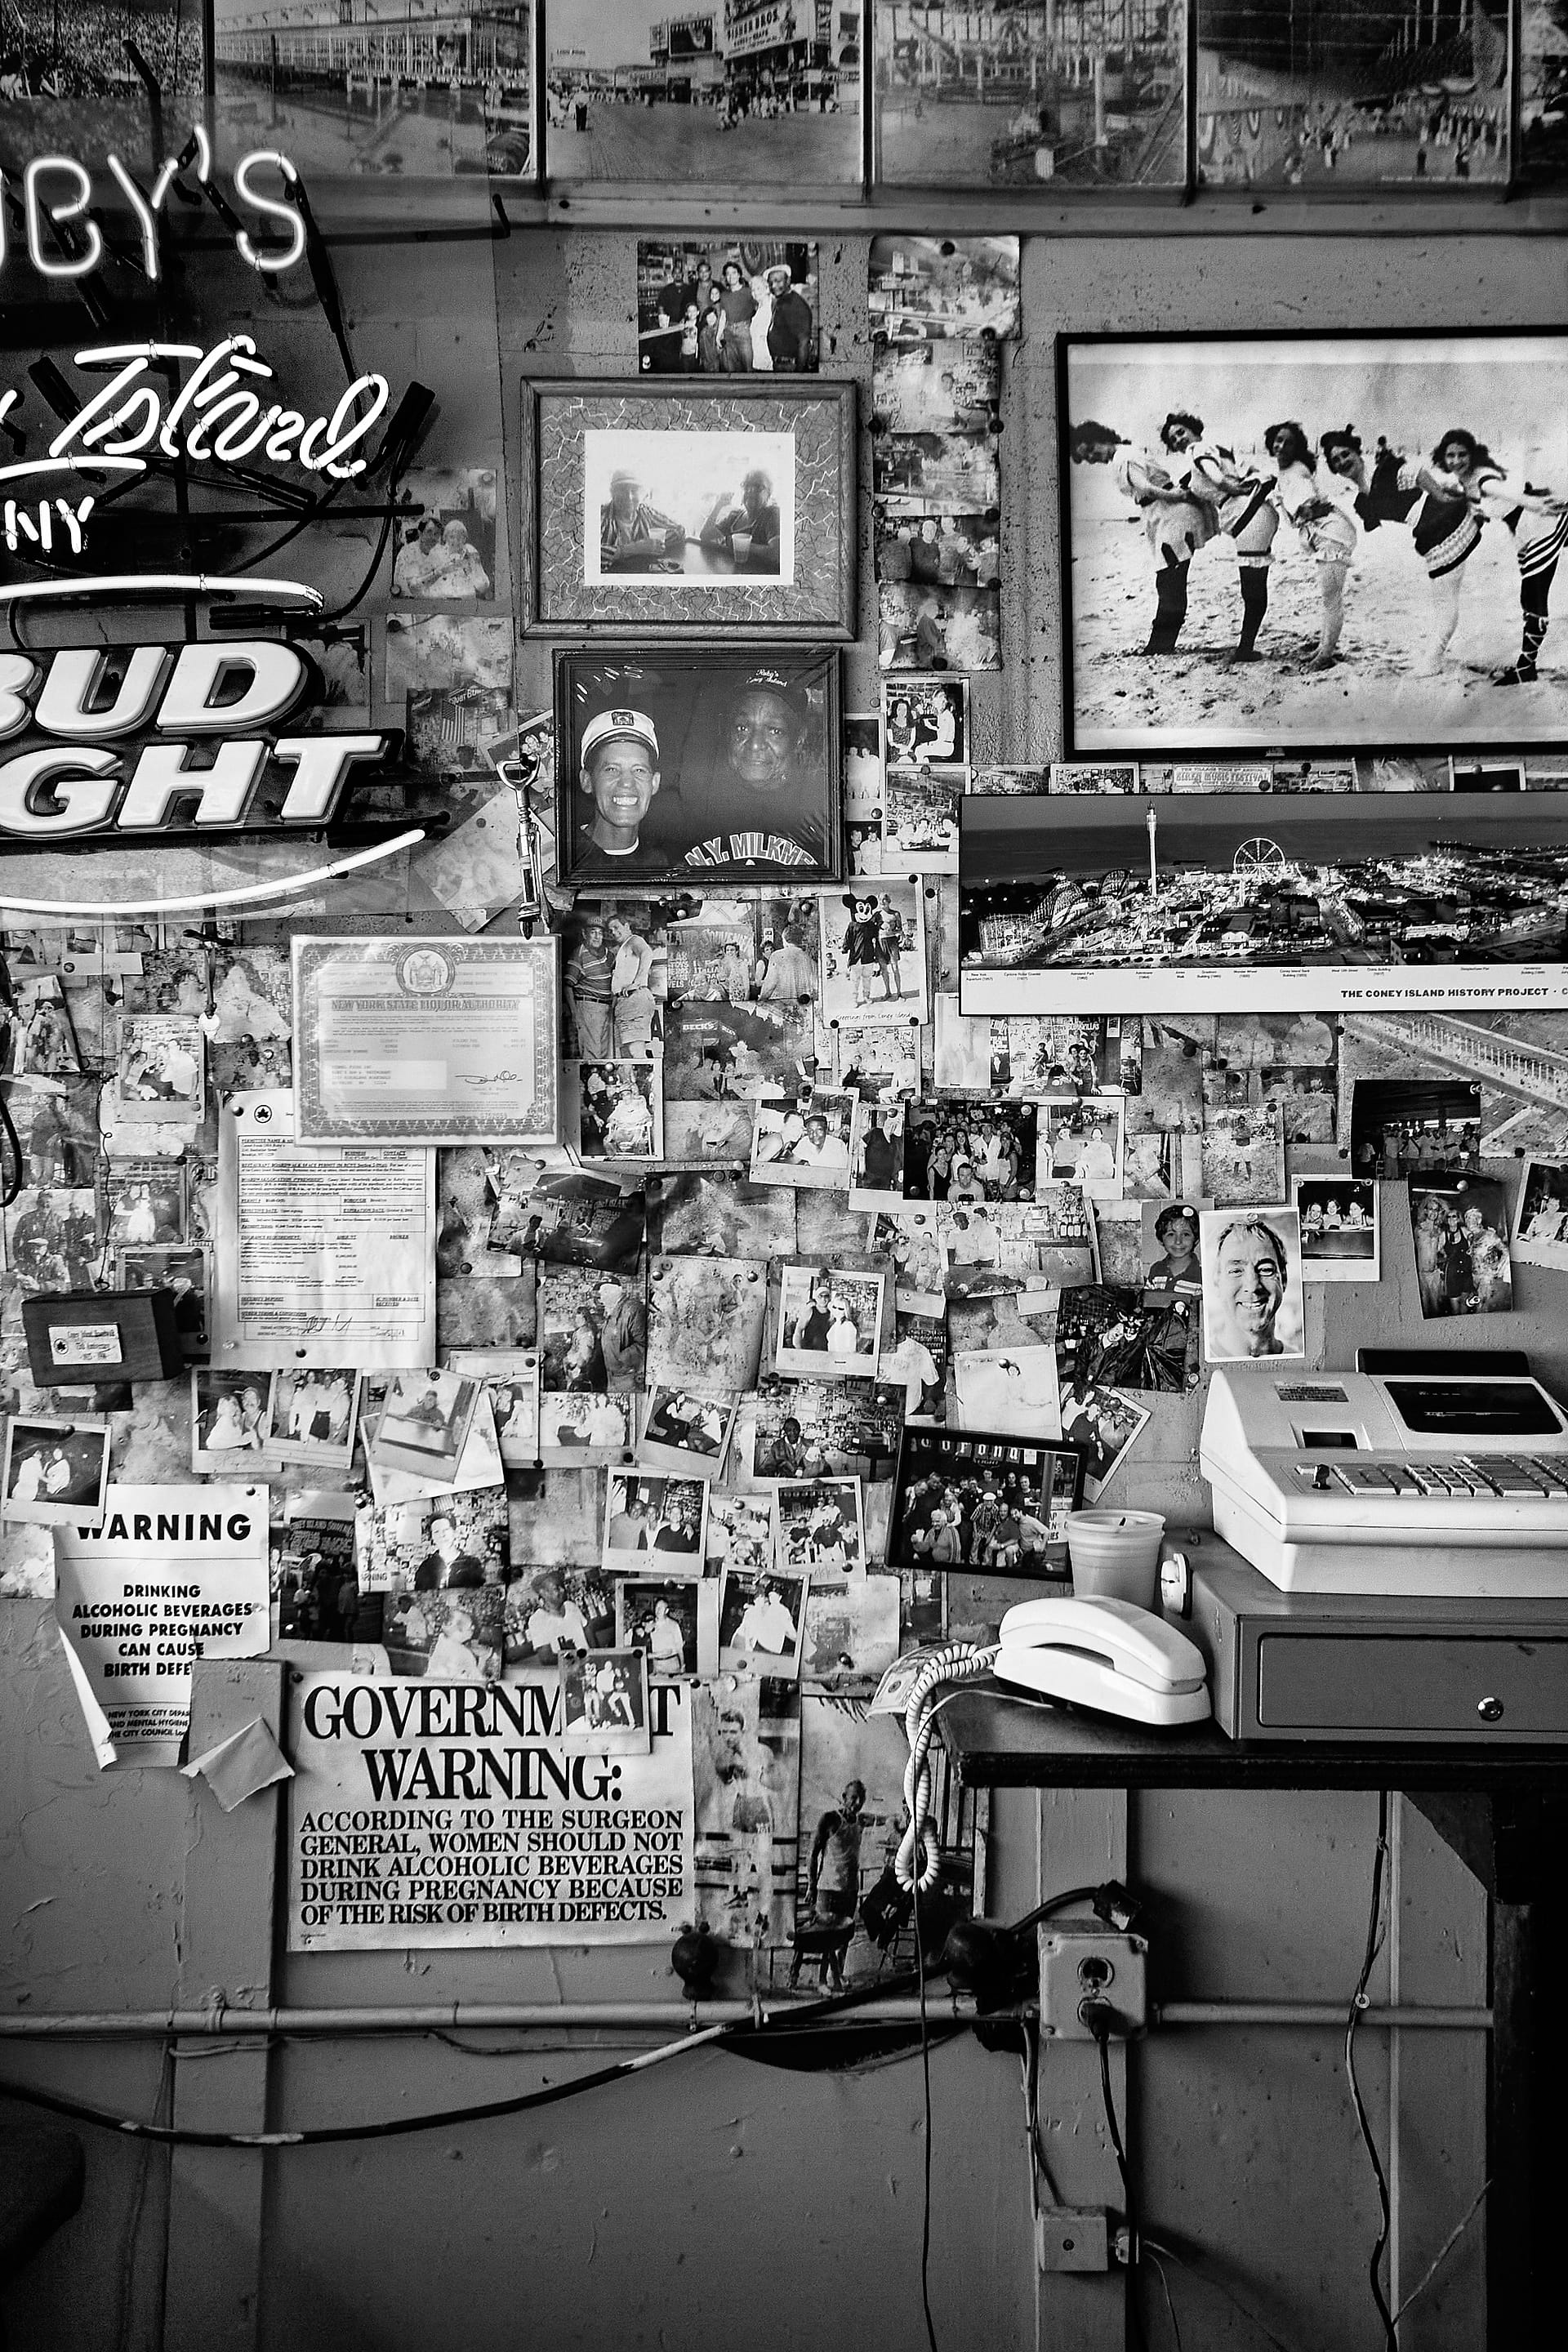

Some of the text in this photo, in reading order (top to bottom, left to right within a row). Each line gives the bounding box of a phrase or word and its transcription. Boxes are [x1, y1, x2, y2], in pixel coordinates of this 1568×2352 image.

[0, 125, 305, 279] BY'S
[49, 335, 390, 479] Island
[3, 496, 95, 553] NY
[684, 832, 818, 866] N.Y. MILKME
[1341, 990, 1362, 998] THE
[1365, 989, 1402, 998] CONEY
[1405, 988, 1445, 997] ISLAND
[1448, 988, 1494, 996] HISTORY
[1498, 987, 1548, 996] PROJECT
[332, 1000, 520, 1012] NEW YORK STATE LIQUOR AUTHORITY
[78, 1514, 252, 1541] WARNING
[123, 1584, 201, 1597] DRINKING
[73, 1602, 252, 1619] ALCOHOLIC BEVERAGES
[81, 1622, 243, 1638] DURING PREGNANCY
[118, 1642, 204, 1656] CAN CAUSE
[104, 1661, 193, 1677] BIRTH DEFE
[152, 1708, 167, 1717] CITY
[305, 1685, 681, 1740] GOVERNMT
[361, 1747, 621, 1802] WARNING:
[300, 1808, 684, 1833] ACCORDING TO THE SURGEON
[301, 1832, 684, 1856] GENERAL, WOMEN SHOULD NOT
[301, 1855, 684, 1879] DRINK ALCOHOLIC BEVERAGES
[301, 1878, 684, 1902] DURING PREGNANCY BECAUSE
[301, 1900, 667, 1925] OF THE RISK OF BIRTH DEFECTS.
